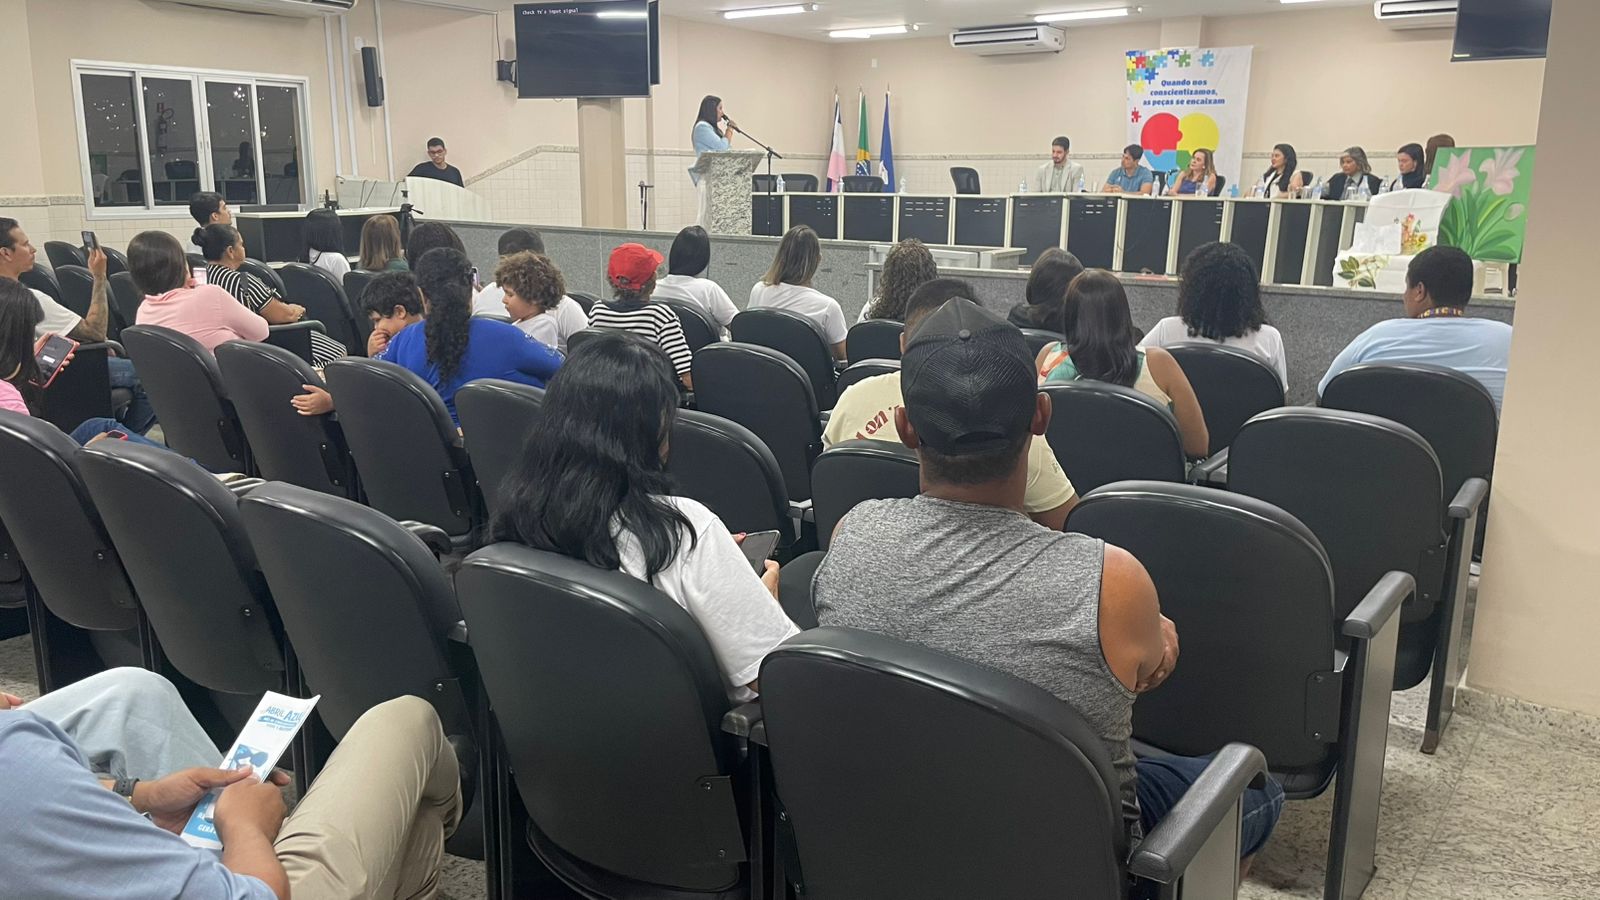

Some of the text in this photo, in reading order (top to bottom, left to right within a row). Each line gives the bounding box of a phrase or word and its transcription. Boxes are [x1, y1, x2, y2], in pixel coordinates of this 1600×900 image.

[1161, 79, 1191, 87] Quando
[1150, 88, 1218, 96] conscientizamos,
[265, 706, 285, 717] ABRIL
